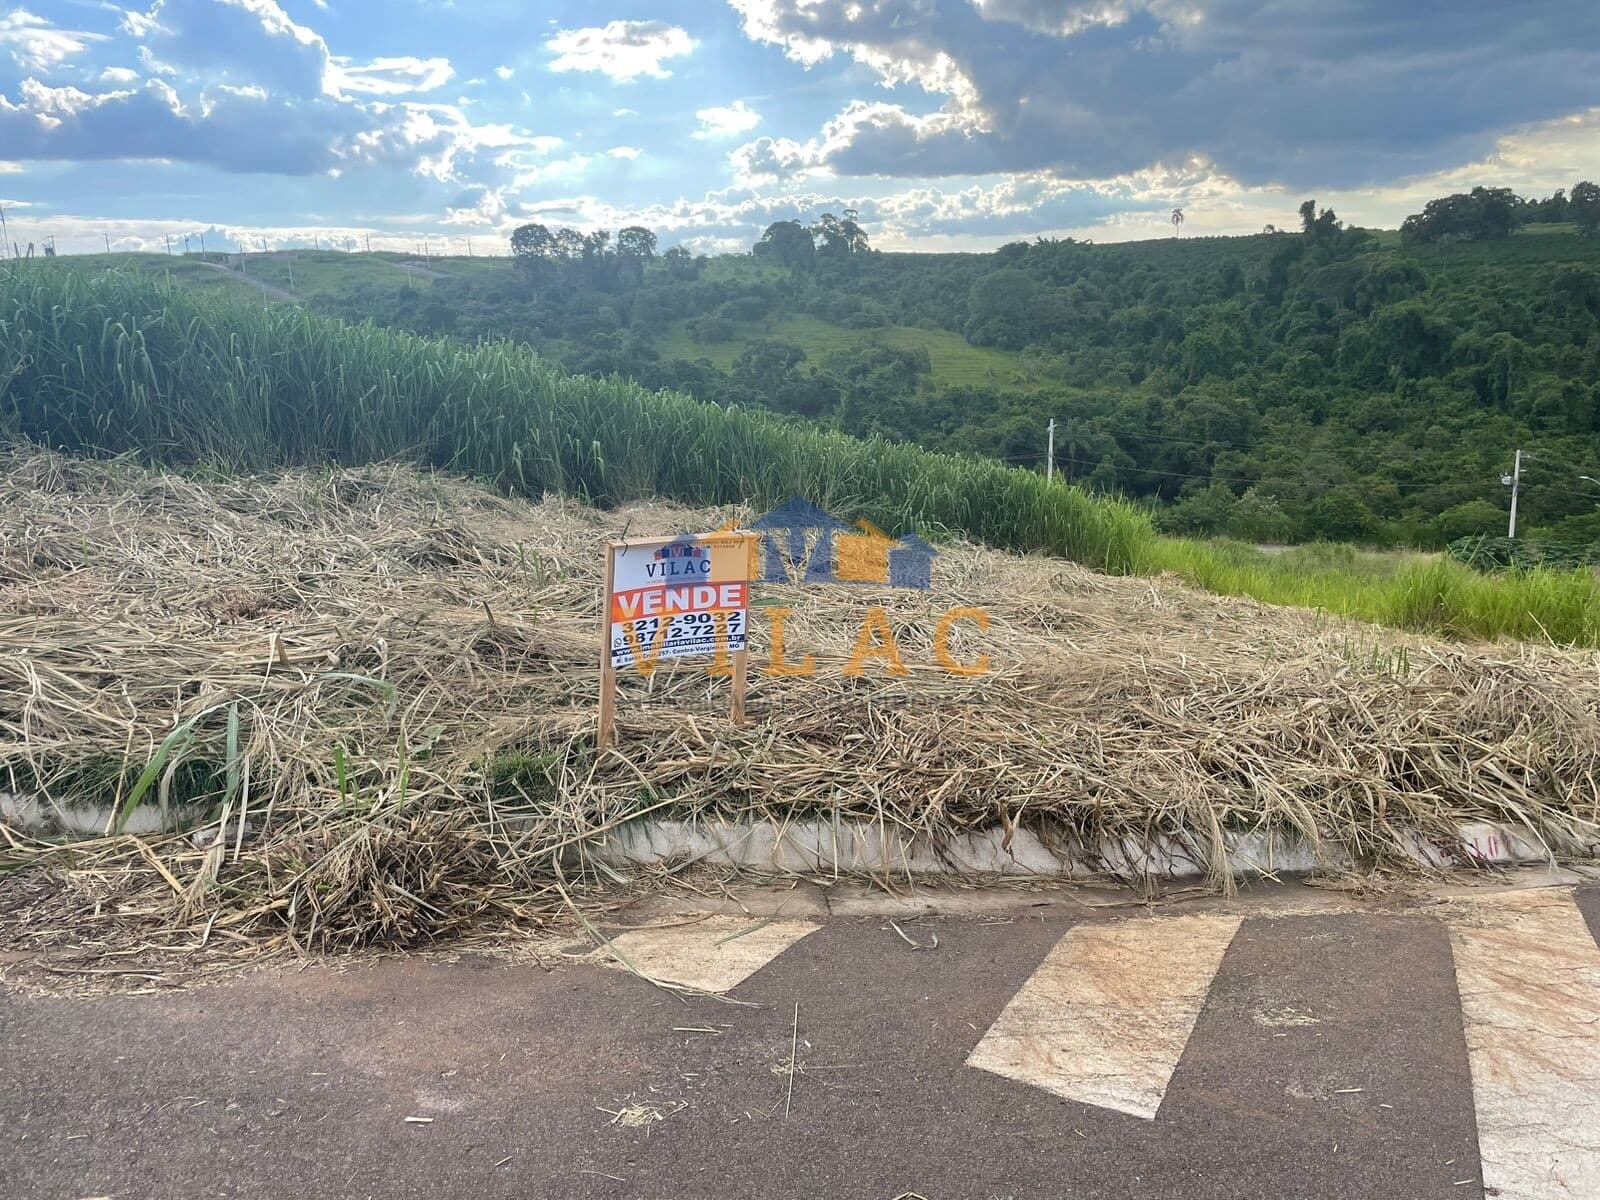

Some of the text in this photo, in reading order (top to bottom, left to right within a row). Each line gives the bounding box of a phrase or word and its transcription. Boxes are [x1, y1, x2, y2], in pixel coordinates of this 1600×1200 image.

[646, 560, 711, 578] VILAC
[618, 584, 742, 618] VENDE
[622, 611, 741, 633] 3212-9032
[623, 623, 741, 646] 98712-7227
